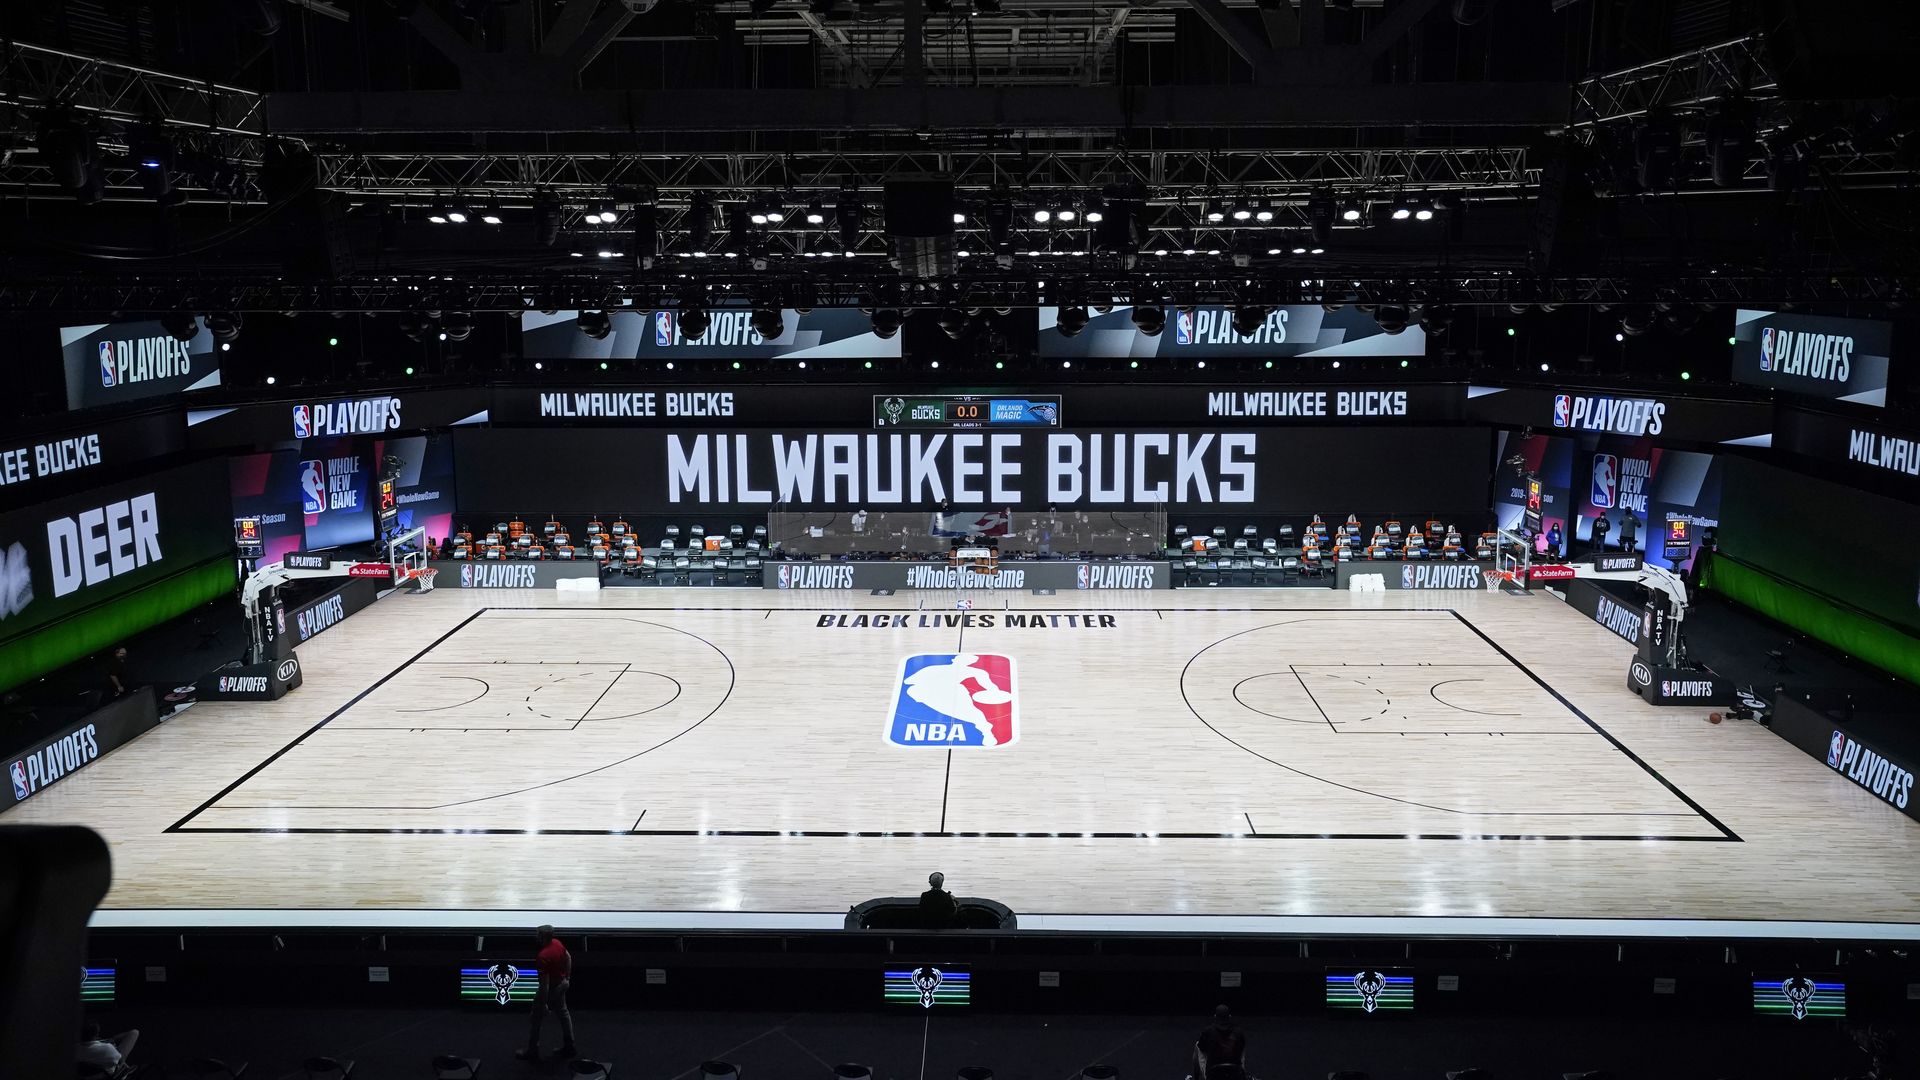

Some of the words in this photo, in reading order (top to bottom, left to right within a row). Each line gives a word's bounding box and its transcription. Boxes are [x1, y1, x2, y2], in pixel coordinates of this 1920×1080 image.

[674, 312, 763, 346] YOFF
[1194, 310, 1288, 344] PLAFS
[1773, 330, 1853, 382] PLAYOFFS
[540, 392, 656, 416] MILWAUKEE
[665, 392, 734, 416] BUCKS
[957, 405, 978, 417] 0.0
[1209, 392, 1327, 416] MILWAUKEE
[1337, 391, 1407, 415] BUCKS
[313, 398, 401, 436] PLAYOFFS
[911, 408, 941, 420] BUCKS
[995, 411, 1022, 420] MAGIC
[1570, 396, 1666, 436] PLAYOFFS
[35, 434, 101, 477] BUCKS
[1849, 429, 1920, 476] MILWAU
[328, 456, 359, 475] WHOLE
[667, 434, 1022, 503] MILWAUKEE
[1048, 433, 1257, 503] BUCKS
[1622, 458, 1652, 478] WHOL
[329, 474, 350, 493] NEW
[1620, 476, 1644, 494] NEW
[305, 501, 317, 510] NBA
[331, 490, 357, 510] GAME
[382, 493, 393, 509] 24
[1530, 492, 1540, 509] 24
[1595, 495, 1606, 504] NBA
[1619, 493, 1648, 512] GAME
[261, 513, 286, 524] Season
[242, 528, 255, 538] 24
[1672, 529, 1685, 538] 24
[47, 492, 162, 598] DEER
[295, 556, 322, 567] PLAYOFFS
[1608, 558, 1635, 569] PLAYOFFS
[473, 564, 536, 588] PLAYOFFS
[790, 565, 854, 588] PLAYOFFS
[1089, 565, 1155, 589] PLAYOFFS
[1415, 564, 1480, 589] PLAYOFFS
[264, 606, 272, 627] NBA
[305, 594, 344, 636] PLAYOFFS
[816, 614, 911, 628] BLACK
[918, 614, 995, 628] LIVES
[1005, 614, 1118, 628] MATTER
[1602, 600, 1641, 643] PLAYOFFS
[267, 628, 274, 642] TV
[1655, 632, 1662, 646] TV
[280, 665, 296, 678] KIA
[1634, 666, 1649, 683] KIA
[226, 676, 268, 692] PLAYOFFS
[1671, 681, 1713, 697] PLAYOFFS
[904, 723, 967, 741] NBA
[26, 723, 98, 793] PLAYOFFS
[1838, 738, 1914, 809] PLAYOFFS
